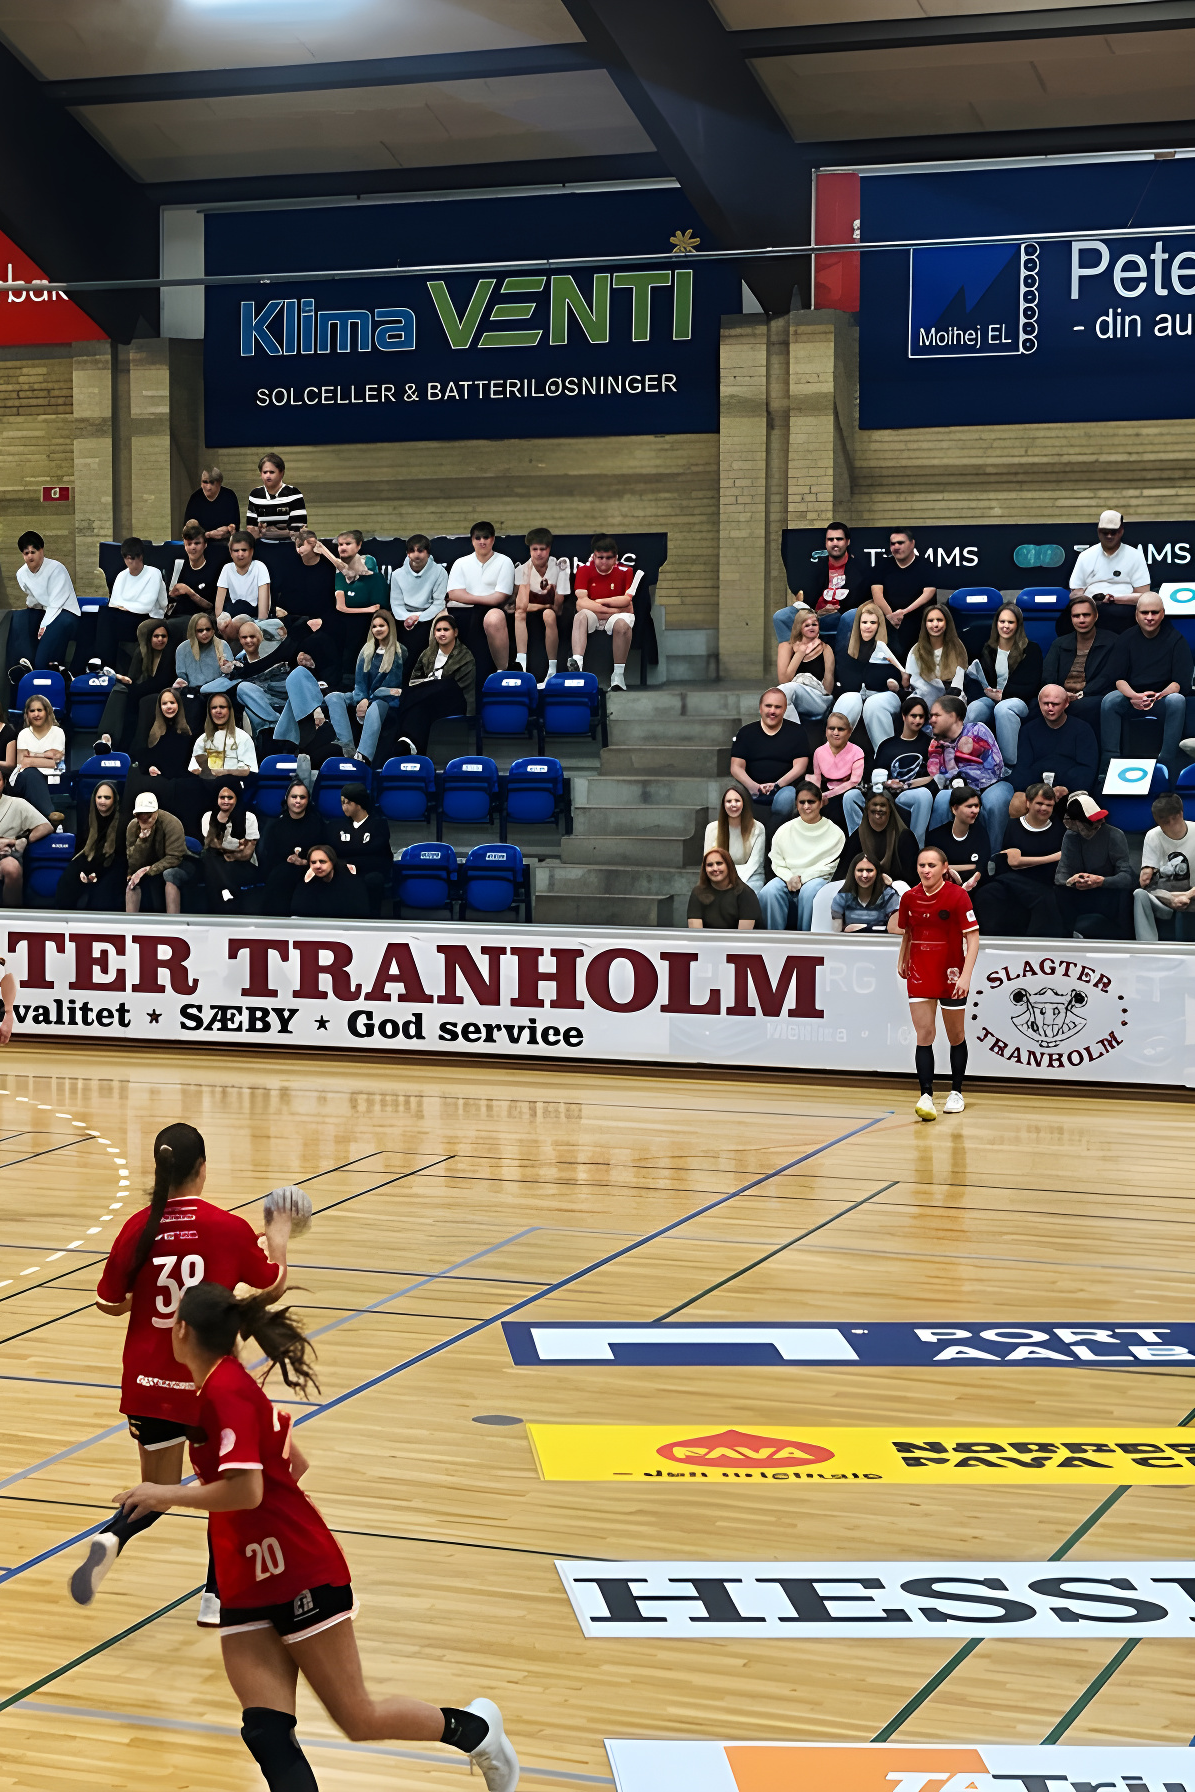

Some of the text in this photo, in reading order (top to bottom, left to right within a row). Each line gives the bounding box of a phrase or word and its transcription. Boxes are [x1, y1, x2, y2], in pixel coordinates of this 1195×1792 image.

[1070, 240, 1195, 300] Pete
[239, 269, 694, 357] Klima VENTI
[1095, 308, 1142, 338] din
[988, 323, 1012, 344] EL
[256, 373, 679, 407] SOLCELLER & BATTERILØSNINGER
[227, 937, 825, 1019] TRANHOLM
[985, 957, 1113, 994] SLAGTER
[179, 1004, 300, 1035] SÆBY
[346, 1009, 425, 1041] God
[438, 1017, 585, 1048] service
[976, 1026, 1124, 1069] TRANHOLM
[913, 1328, 1171, 1344] PORT
[932, 1345, 1195, 1361] AALB
[244, 1536, 286, 1582] 20
